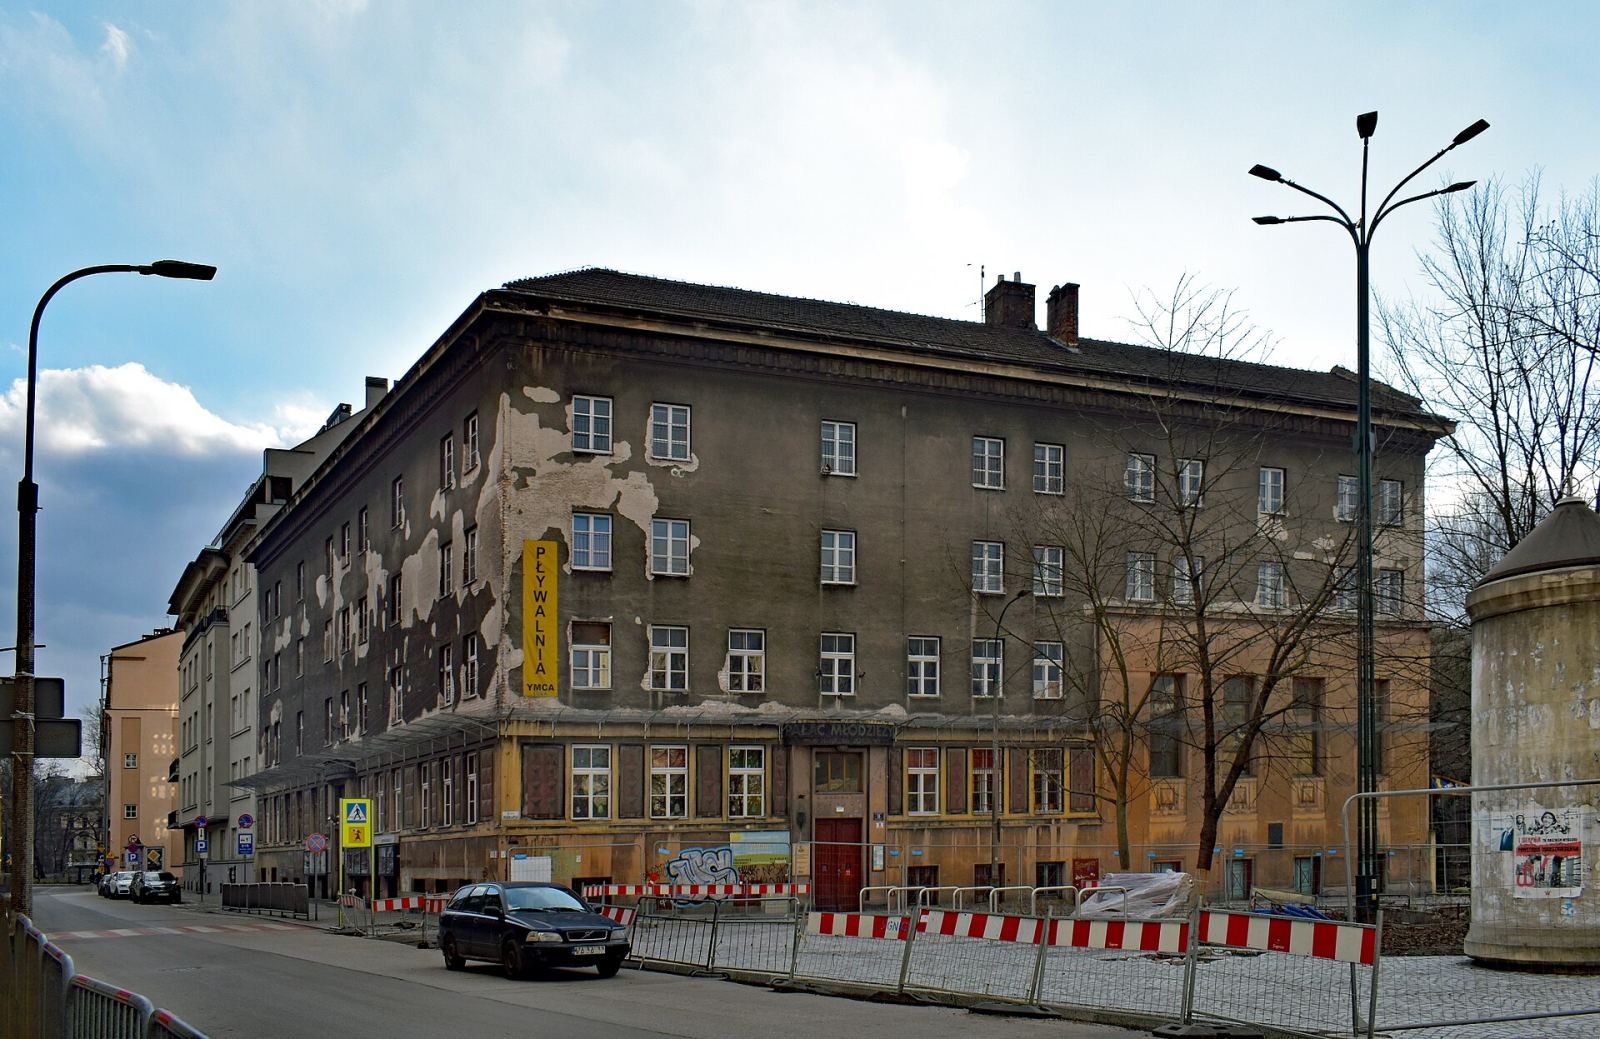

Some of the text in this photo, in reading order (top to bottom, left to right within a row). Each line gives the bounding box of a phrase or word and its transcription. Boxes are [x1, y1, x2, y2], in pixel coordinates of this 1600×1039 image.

[533, 546, 548, 675] PŁYWALNIA
[527, 683, 554, 691] YMCA
[786, 725, 825, 736] PAŁAC
[197, 842, 205, 851] P
[130, 853, 137, 861] P
